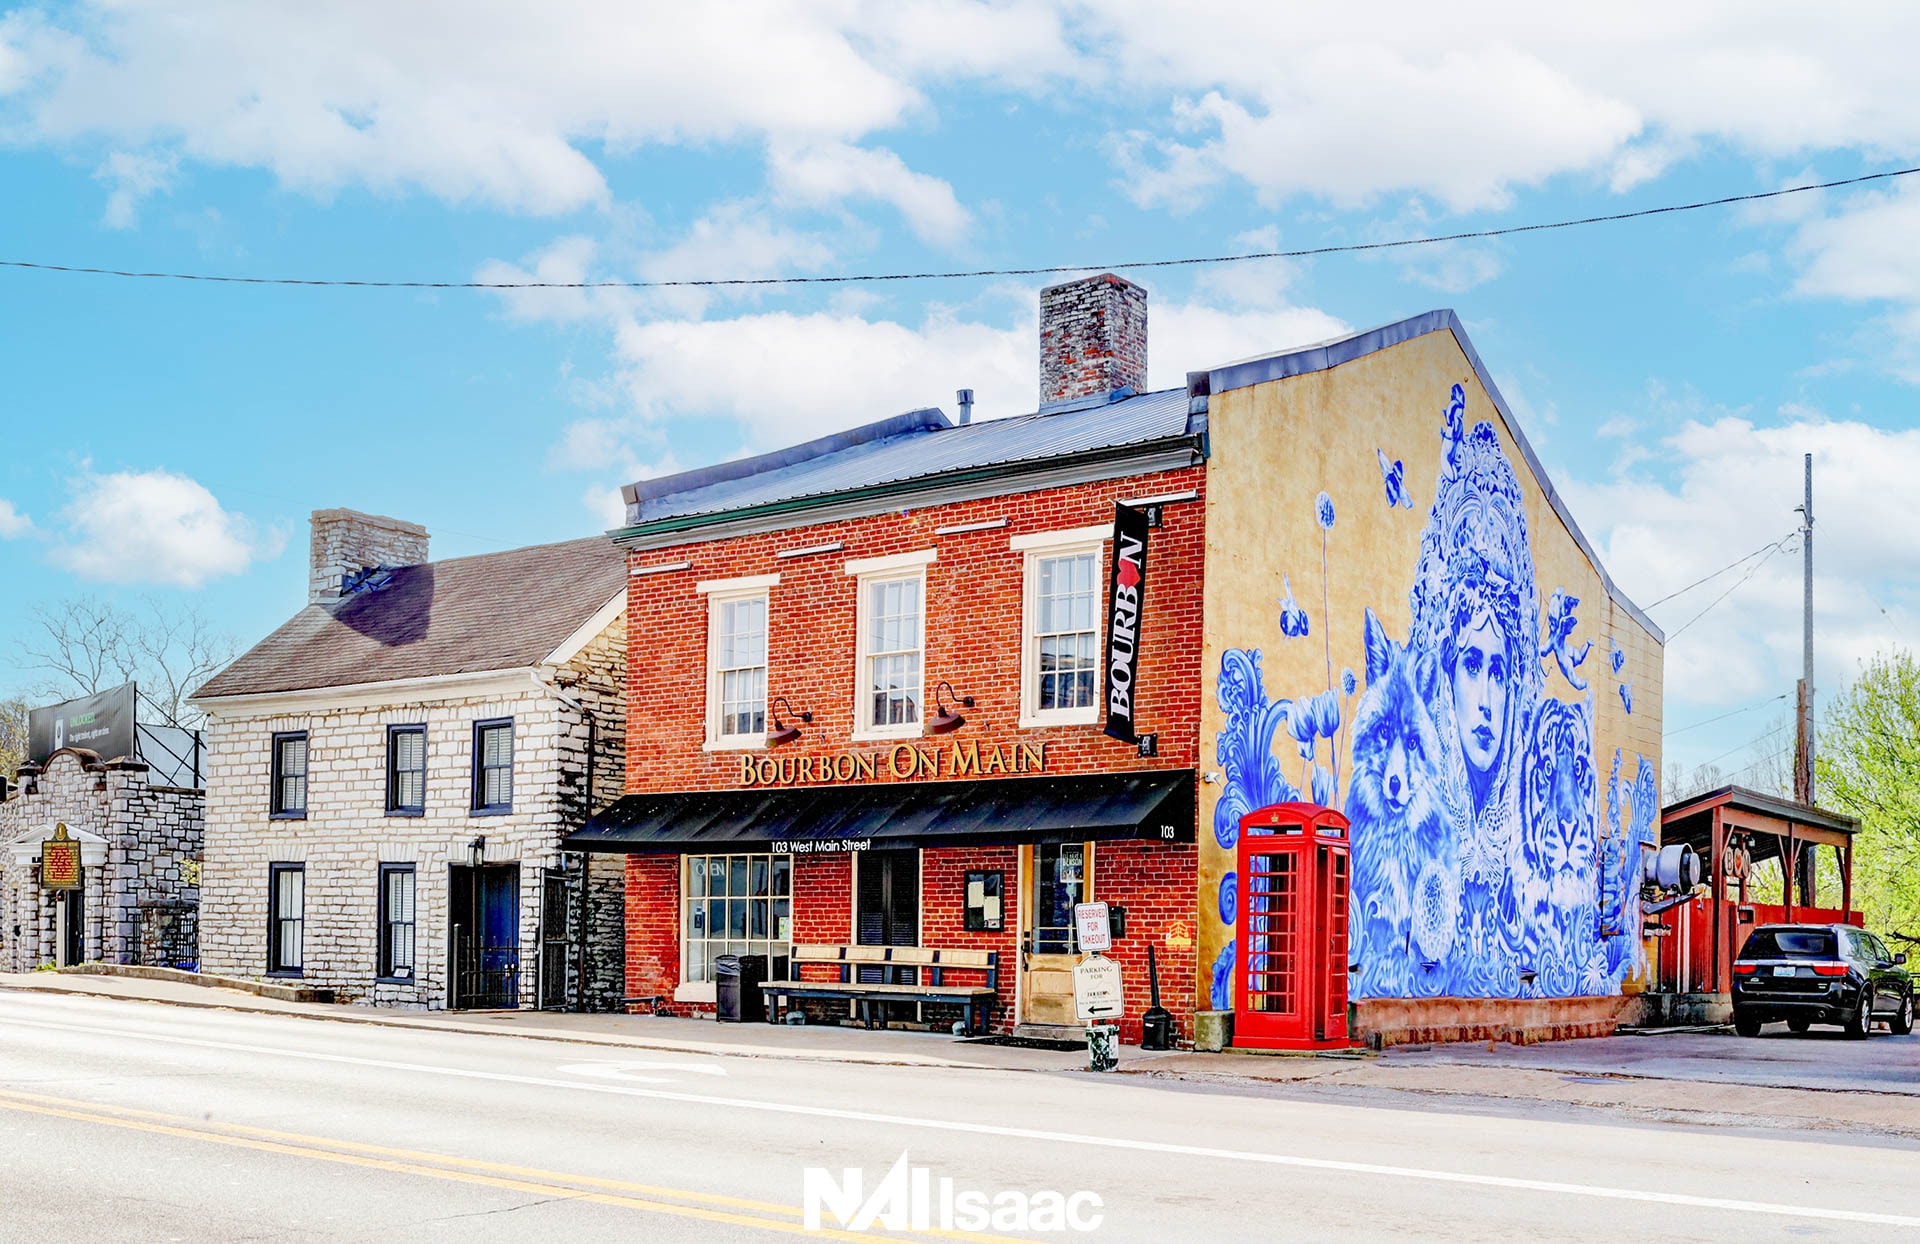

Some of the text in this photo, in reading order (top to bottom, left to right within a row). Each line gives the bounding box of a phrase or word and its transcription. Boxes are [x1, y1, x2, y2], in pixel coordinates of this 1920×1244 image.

[740, 739, 1046, 786] BOURBON ON MAIN
[1160, 824, 1175, 839] 103
[771, 838, 871, 853] 103 West Main Street
[695, 862, 725, 877] OEN
[1078, 908, 1106, 920] RESERVED
[1087, 921, 1099, 932] FOR
[1082, 933, 1106, 945] TAKEOUT
[1080, 966, 1113, 974] PARKING
